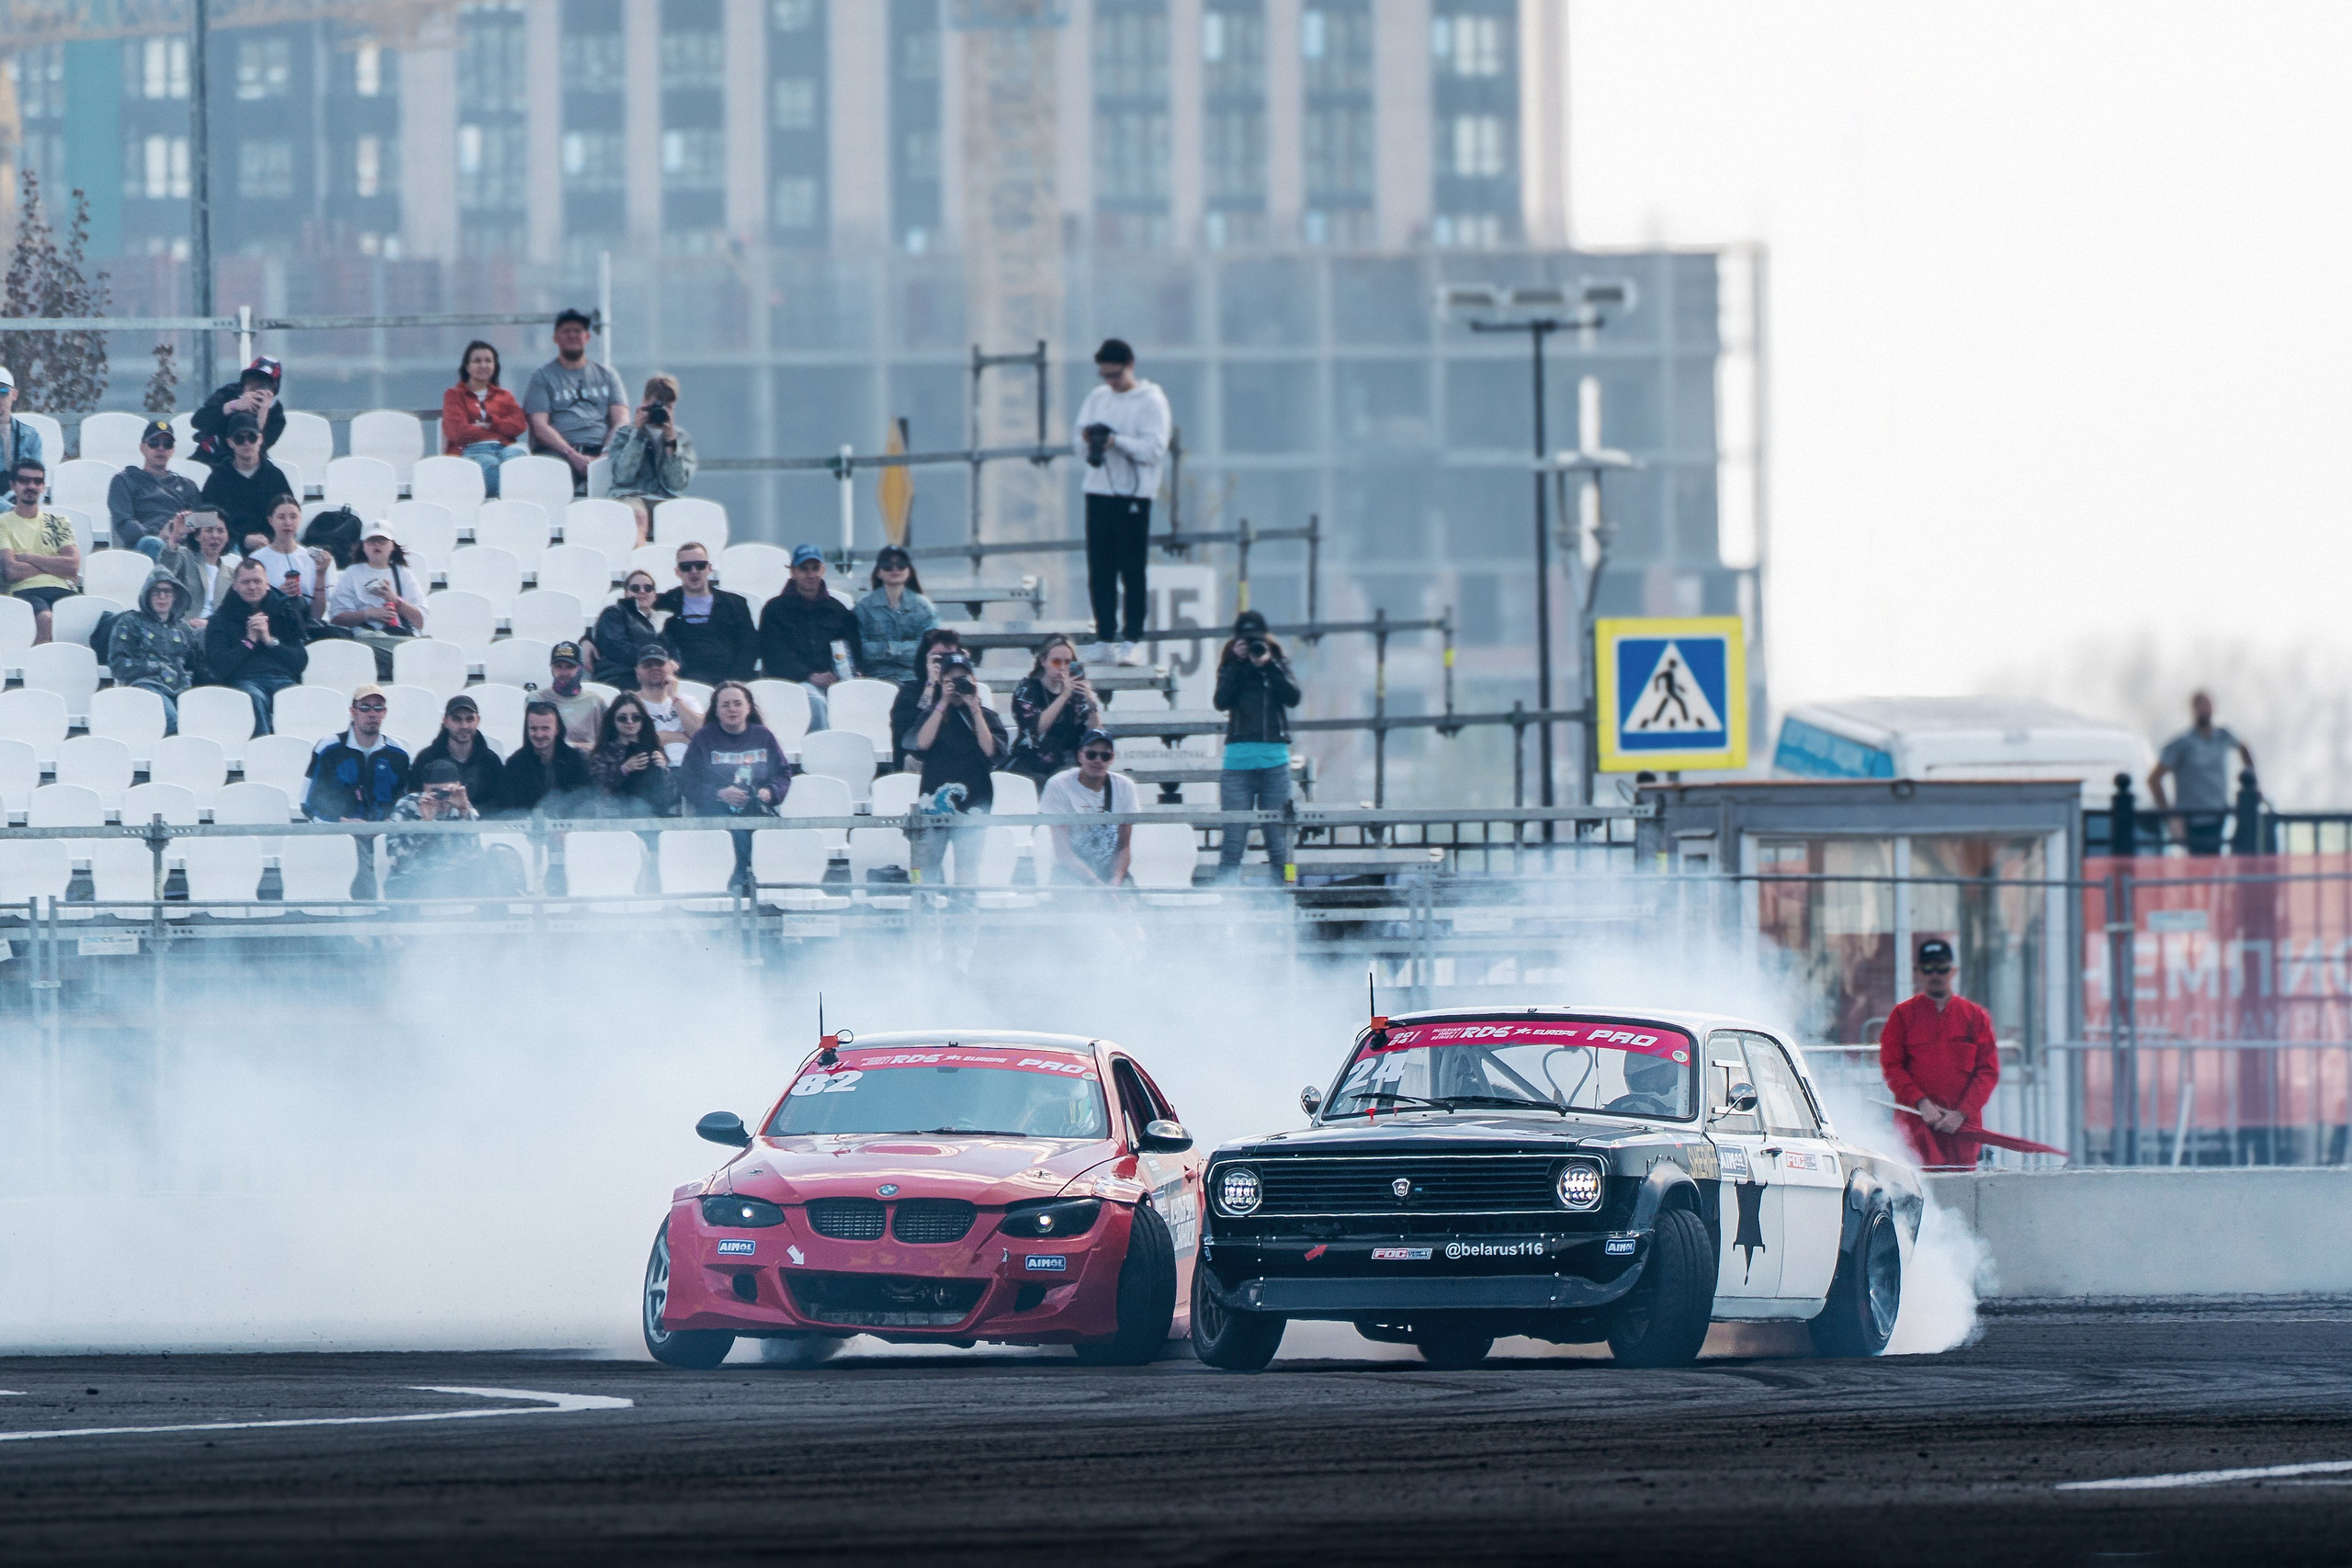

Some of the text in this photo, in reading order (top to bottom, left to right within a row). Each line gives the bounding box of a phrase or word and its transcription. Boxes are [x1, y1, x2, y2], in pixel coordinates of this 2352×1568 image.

[1459, 1026, 1658, 1047] RDS EUROPE PRO
[1016, 1058, 1087, 1074] PRO
[1340, 1052, 1408, 1094] 24
[790, 1069, 864, 1097] 82
[1374, 1249, 1408, 1258] FDC
[1445, 1242, 1544, 1259] @belarus116
